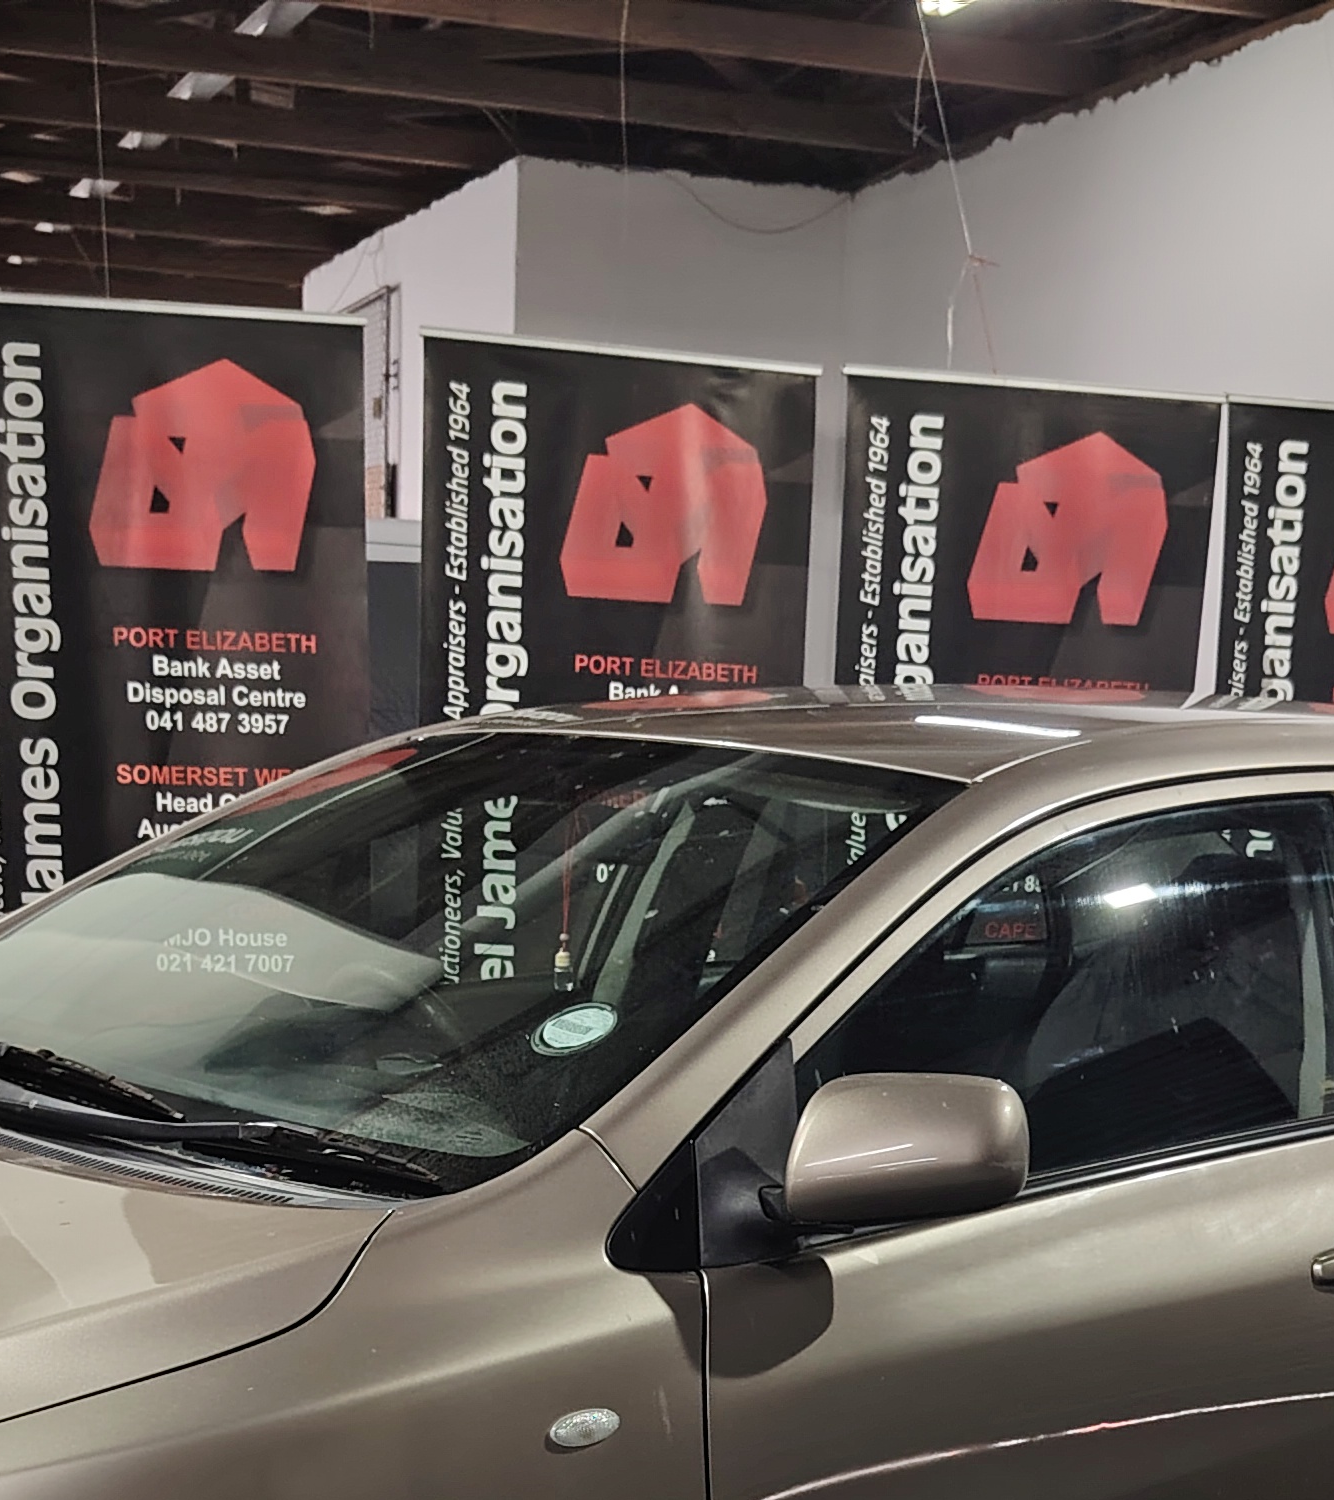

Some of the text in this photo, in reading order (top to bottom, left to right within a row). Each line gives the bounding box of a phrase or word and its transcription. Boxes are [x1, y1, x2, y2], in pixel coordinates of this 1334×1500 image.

[448, 380, 471, 442] 1964
[867, 414, 891, 473] 1964
[1243, 441, 1264, 496] 1964
[445, 446, 470, 582] Established
[859, 476, 887, 607] Established
[1233, 499, 1260, 624] Established
[113, 626, 317, 654] PORT ELIZABETH
[152, 654, 281, 681] Bank Asset
[443, 599, 470, 720] Appraisers
[574, 654, 758, 684] PORT ELIZABETH
[126, 681, 307, 709] Disposal Centre
[145, 710, 290, 735] 041 487 3957
[116, 764, 248, 787] SOMERSET
[156, 792, 213, 813] Head
[218, 928, 288, 947] House
[984, 922, 1037, 940] CAPE
[156, 953, 295, 973] 021 421 7007
